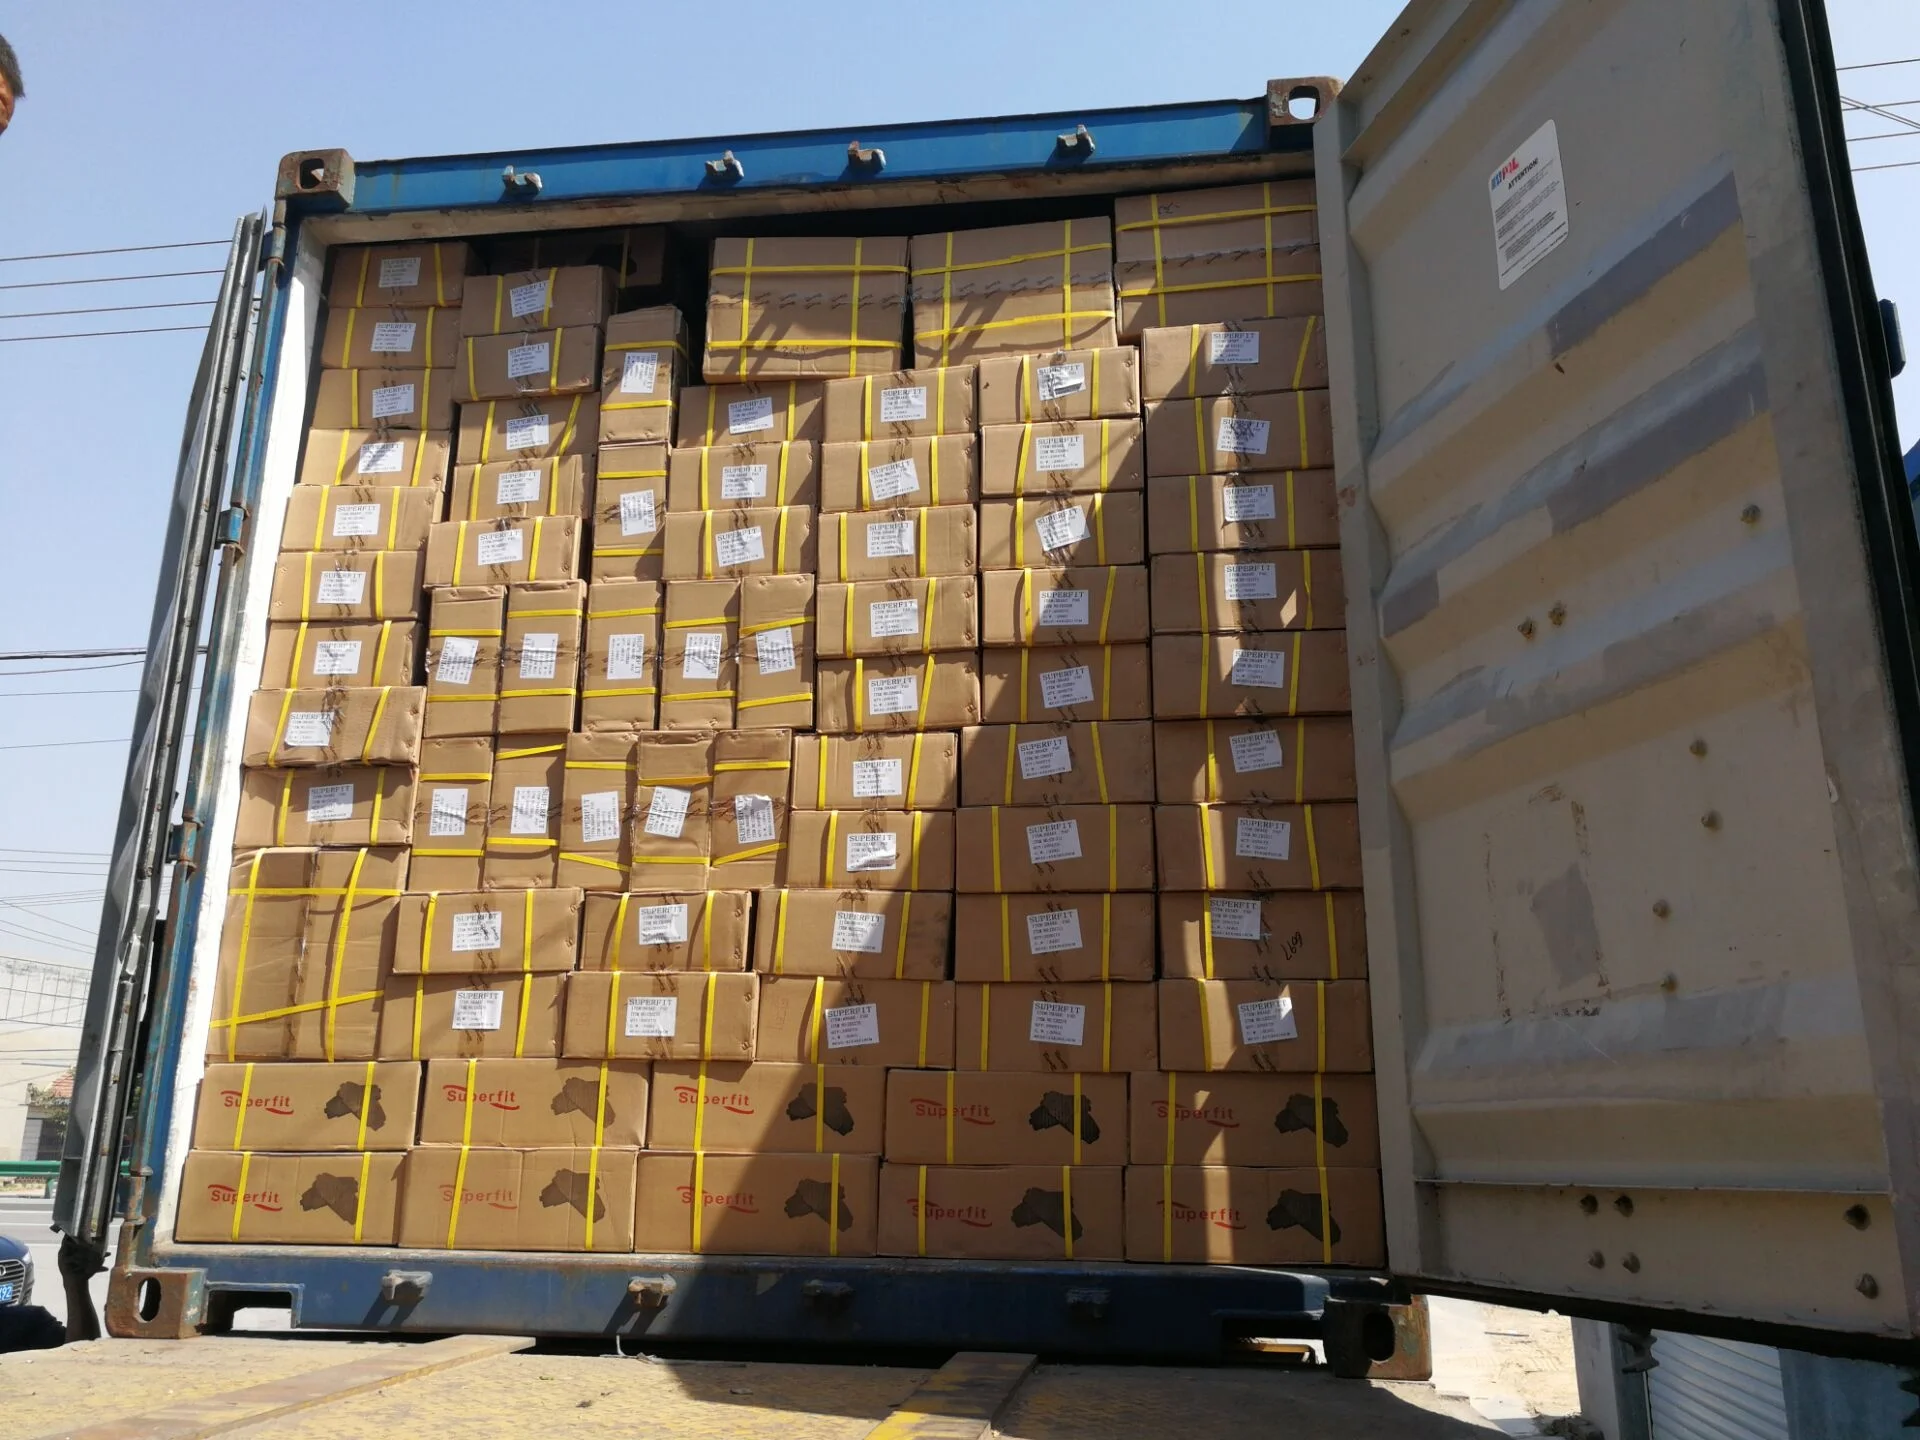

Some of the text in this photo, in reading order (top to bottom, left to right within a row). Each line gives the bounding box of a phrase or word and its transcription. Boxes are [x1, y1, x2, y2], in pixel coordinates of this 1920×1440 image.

[1508, 157, 1539, 190] ATTENTION
[510, 344, 545, 355] SUPERFIT
[373, 385, 411, 395] SUPERFIT
[883, 389, 923, 397] SUPERFIT
[730, 399, 768, 409] SUPERFIT
[507, 416, 545, 426] SUPERFIT
[1038, 436, 1079, 445] SUPERFIT
[724, 466, 763, 474] SUPERFIT
[870, 460, 910, 473] SUPERFIT
[501, 471, 536, 480] SUPERFIT
[1225, 486, 1268, 495] SUPERFIT
[480, 530, 519, 541] SUPERFIT
[1226, 564, 1271, 573] SUPERFIT
[1041, 591, 1084, 599] SUPERFIT
[872, 601, 914, 610] SUPERFIT
[634, 635, 643, 674] SUPERFIT
[1235, 650, 1280, 660] SUPERFIT
[1042, 668, 1084, 681] SUPERFIT
[871, 677, 912, 687] SUPERFIT
[1232, 733, 1276, 744] SUPERFIT
[1021, 739, 1063, 752] SUPERFIT
[855, 761, 897, 769] SUPERFIT
[311, 785, 352, 793] SUPERFIT
[1028, 822, 1072, 834] SUPERFIT
[1240, 819, 1285, 830] SUPERFIT
[1210, 899, 1256, 910] SUPERFIT
[641, 906, 683, 915] SUPERFIT
[838, 913, 880, 922] SUPERFIT
[1028, 911, 1072, 923] SUPERFIT
[458, 992, 499, 1000] SUPERFIT
[1035, 1003, 1081, 1014] SUPERFIT
[1240, 1001, 1287, 1012] SUPERFIT
[828, 1007, 872, 1017] SUPERFIT
[441, 1189, 511, 1203] Sperfit
[681, 1191, 752, 1206] Sperfit
[1161, 1206, 1238, 1222] uperfit
